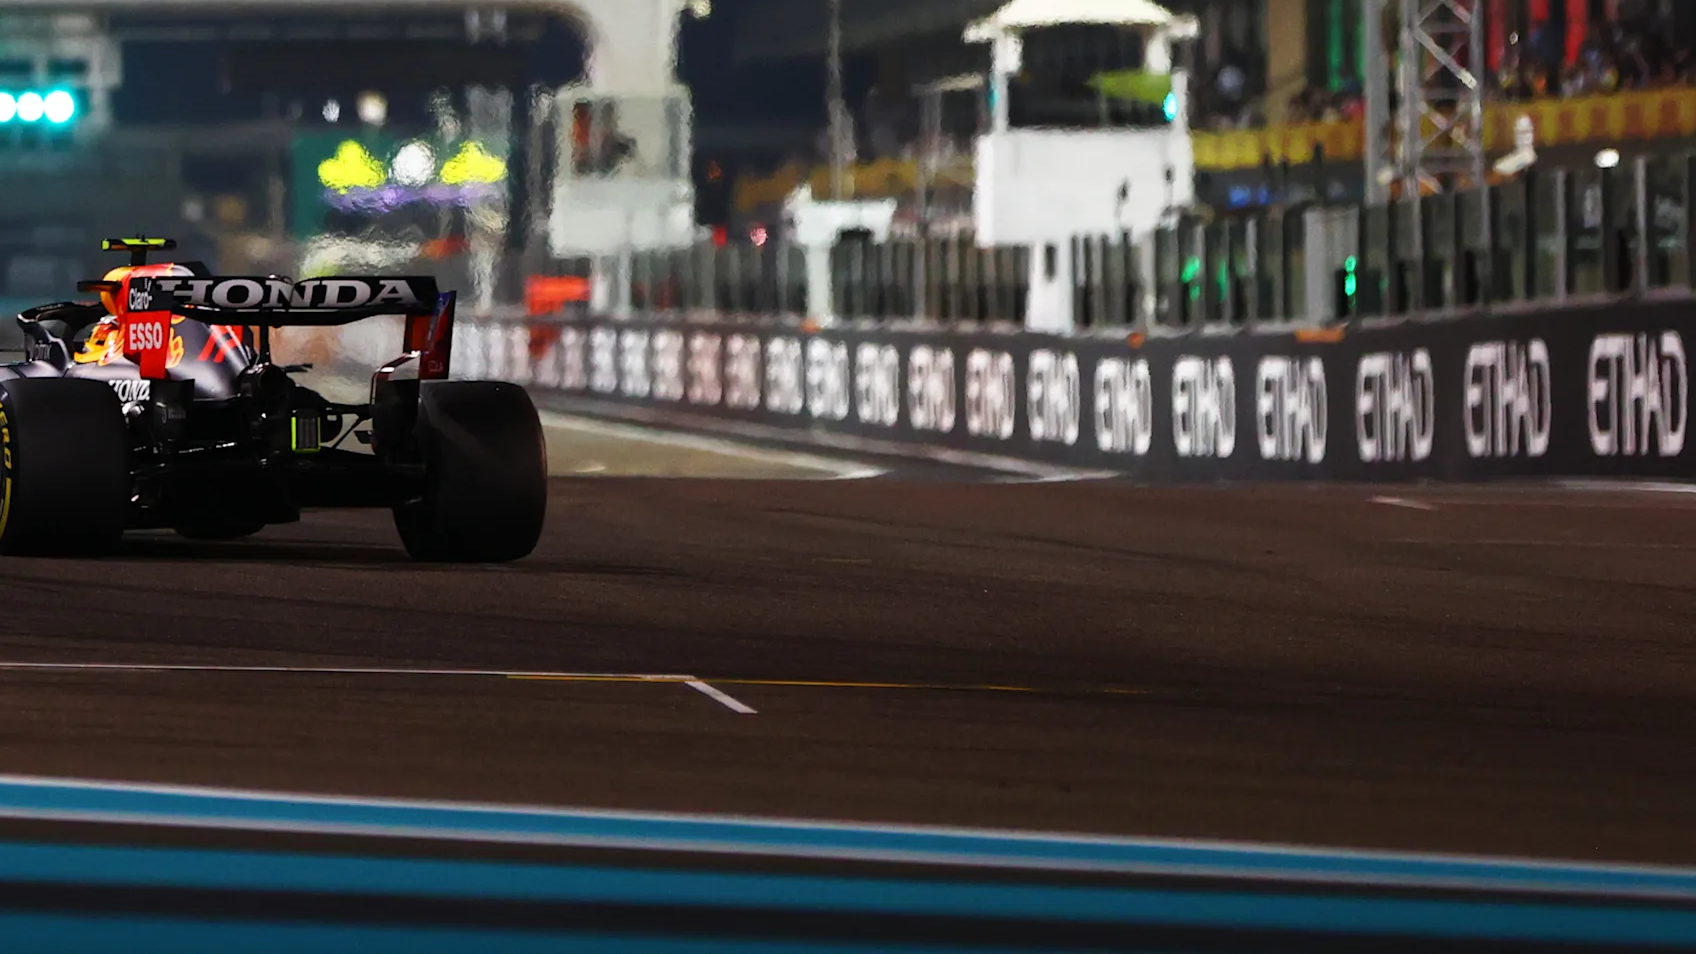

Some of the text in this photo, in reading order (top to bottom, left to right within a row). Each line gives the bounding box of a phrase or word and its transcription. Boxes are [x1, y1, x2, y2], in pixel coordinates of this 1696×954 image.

[129, 320, 163, 351] ESSO
[156, 278, 421, 309] HONDA
[1356, 347, 1435, 463] ETIHAD
[1463, 337, 1552, 457] ETIHAD
[1587, 329, 1688, 457] ETIHAD
